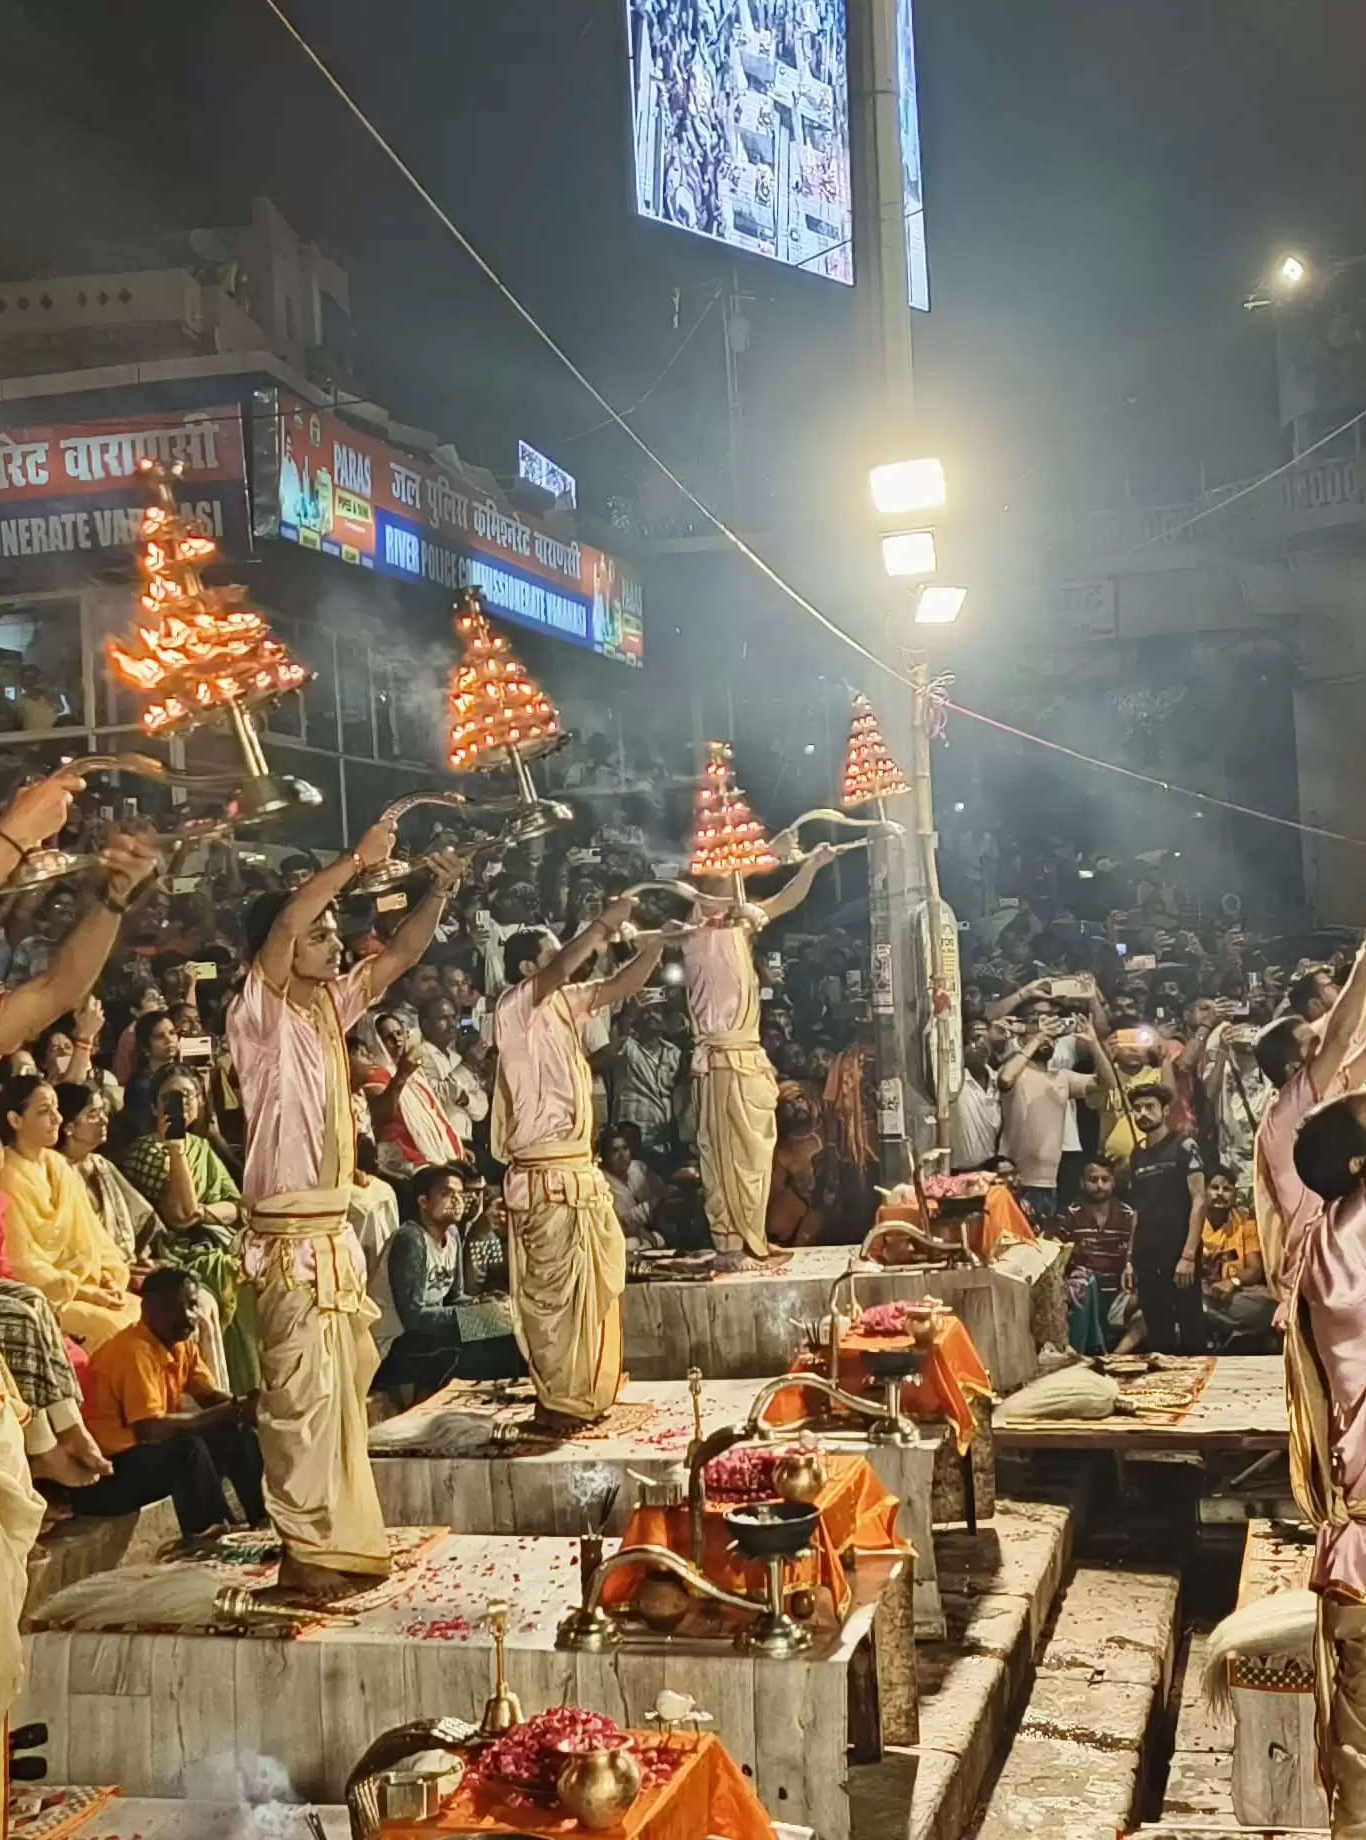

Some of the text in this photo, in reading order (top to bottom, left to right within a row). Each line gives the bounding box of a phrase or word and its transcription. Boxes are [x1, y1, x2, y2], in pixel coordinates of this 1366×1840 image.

[60, 412, 220, 481] वाराणसी
[333, 440, 372, 500] PARAS
[93, 500, 224, 548] VARASI
[389, 462, 581, 580] जल पुलिस कमिश्नरेट वाराणसी
[385, 524, 420, 574] RIVER
[421, 539, 458, 591] POLICE
[458, 553, 547, 625] COMMISSIONERATE
